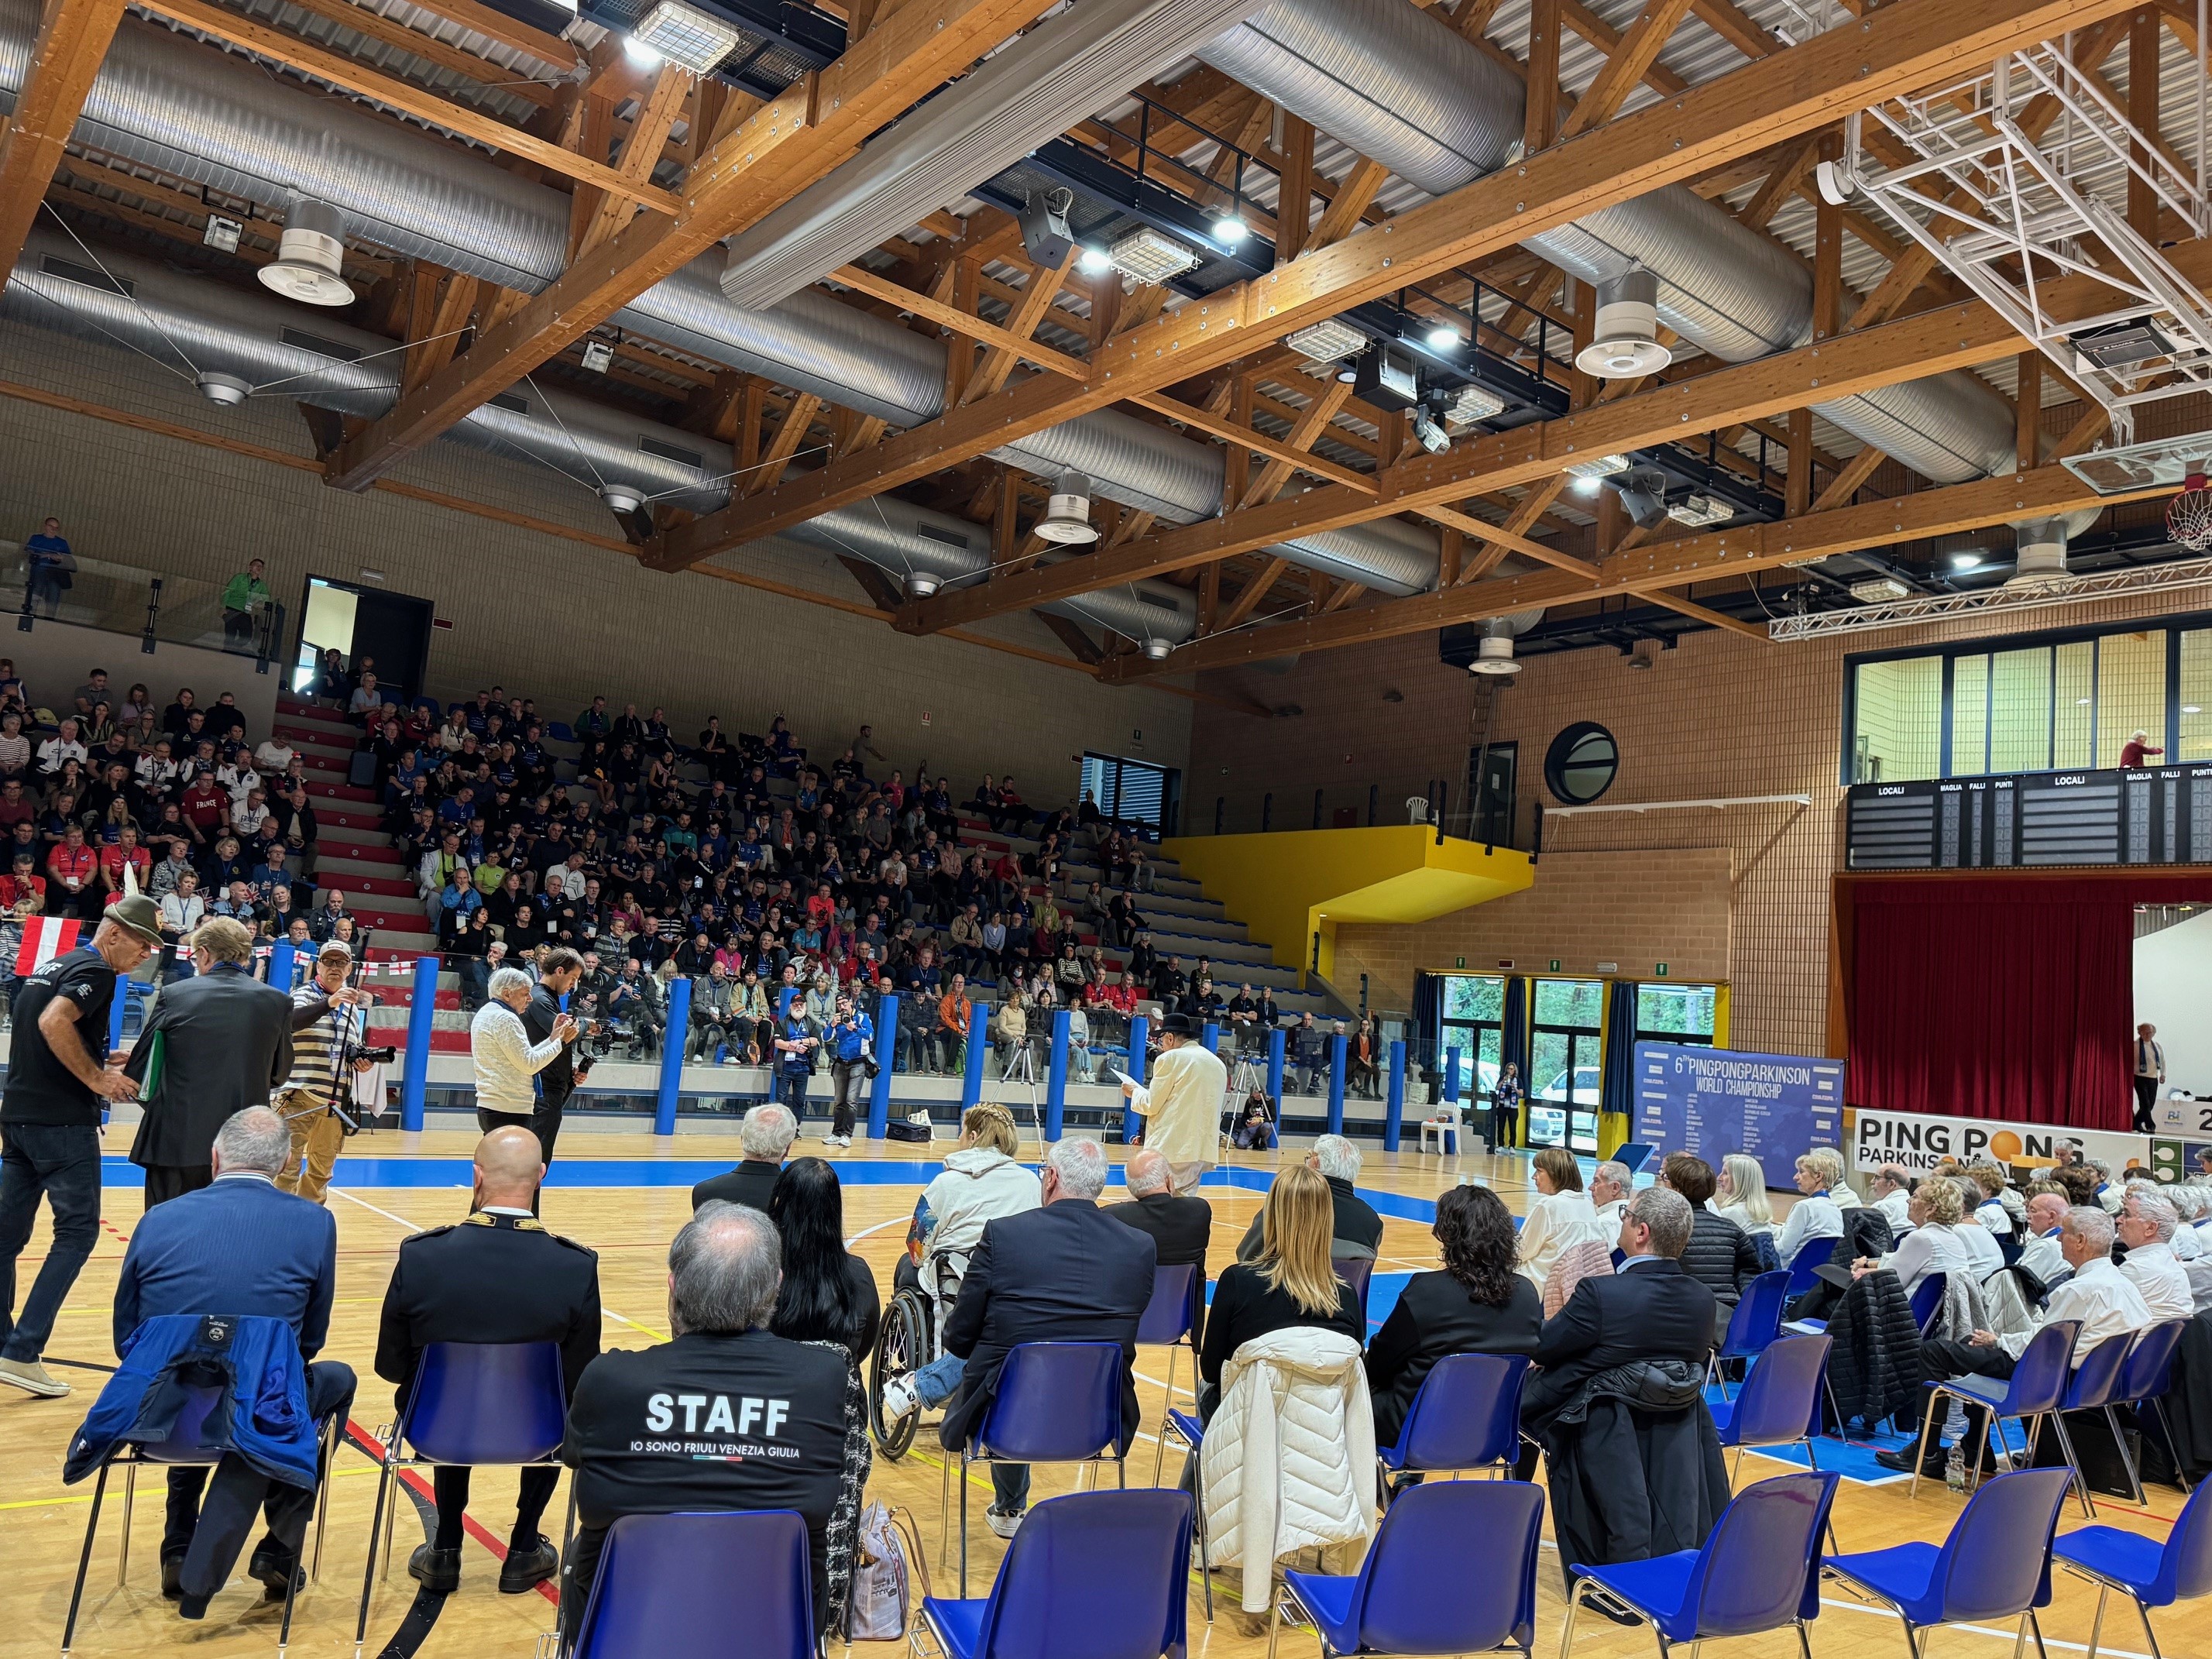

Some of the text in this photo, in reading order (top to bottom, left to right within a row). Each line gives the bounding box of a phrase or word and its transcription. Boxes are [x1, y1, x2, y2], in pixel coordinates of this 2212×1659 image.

[1878, 786, 1905, 795] LOCALI
[1994, 781, 2013, 789] PUNTI
[2055, 775, 2085, 786] LOCALI
[2126, 772, 2152, 781] MAGLIA
[2161, 770, 2180, 778] FALLI
[196, 799, 217, 809] FRANCE
[1688, 1058, 1810, 1086] PINGPONGPARKINSON
[1696, 1076, 1782, 1099] WORLD CHAMPIONSHIP
[1860, 1118, 1950, 1154] PING
[646, 1393, 790, 1437] STAFF
[630, 1441, 800, 1458] IO SONO FRIULI VENEZIA GIULIA
